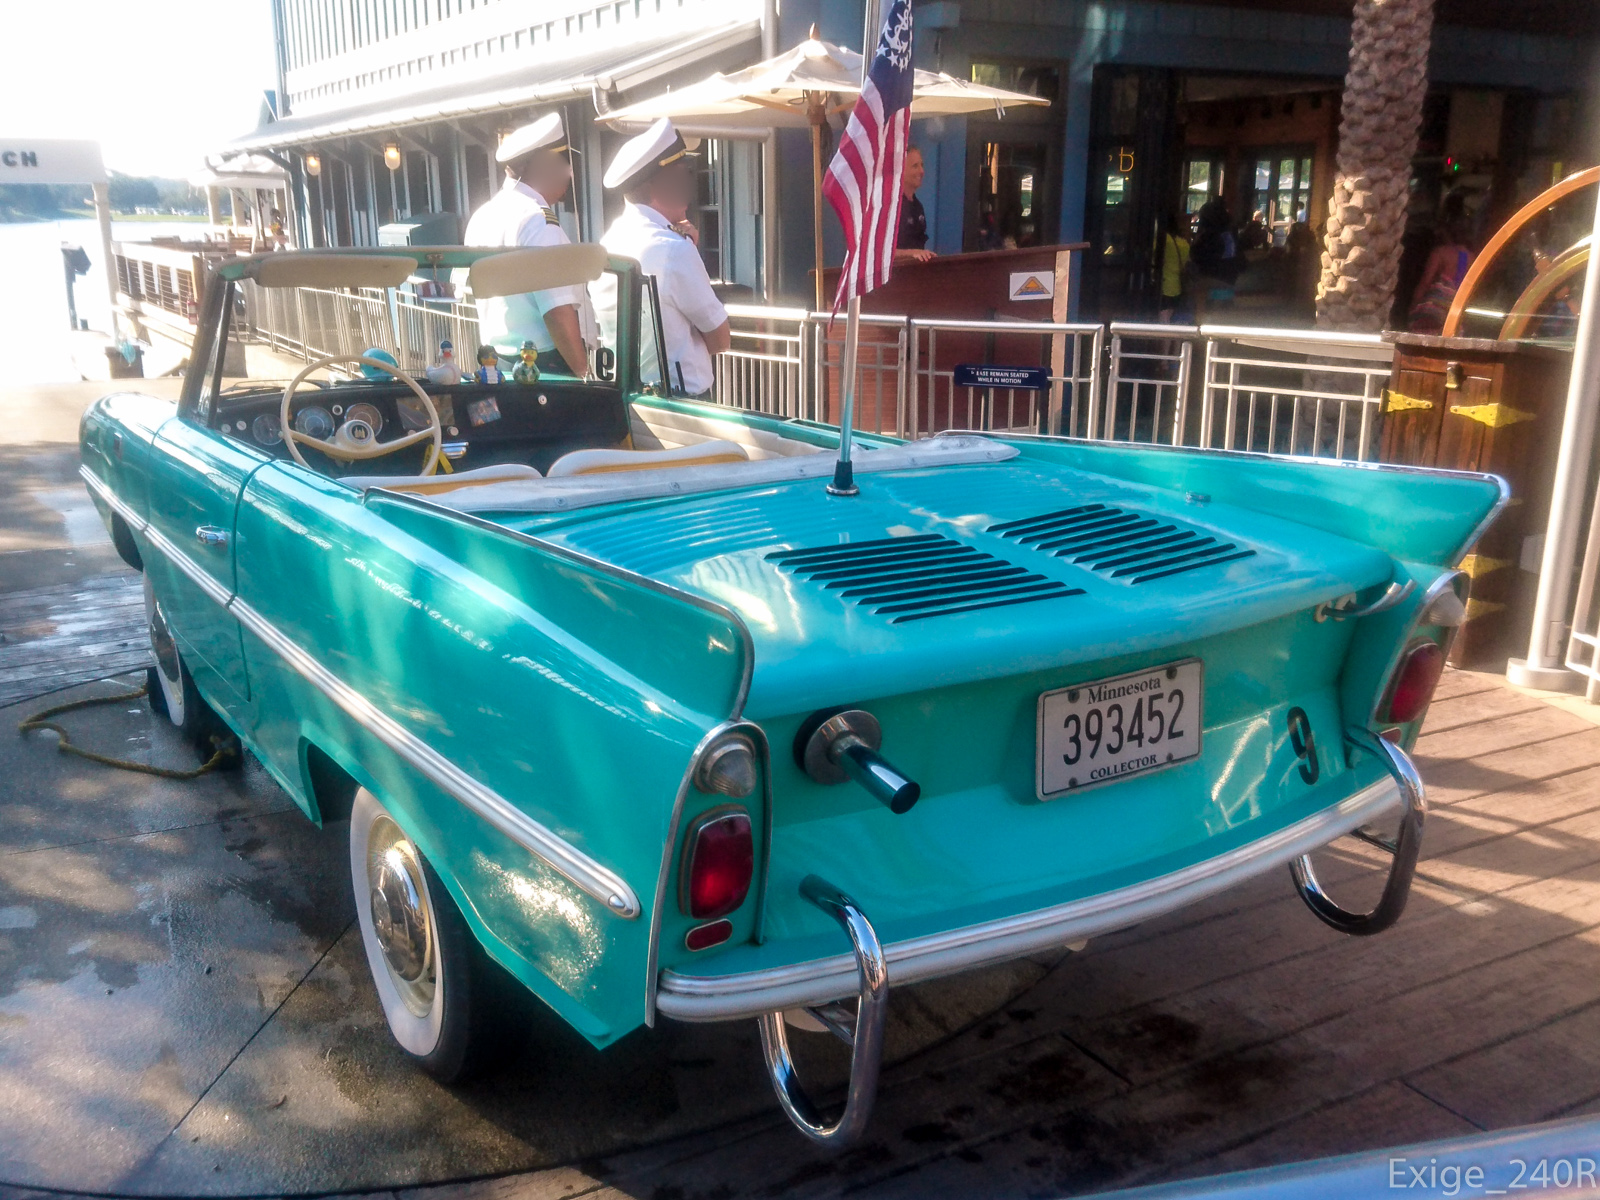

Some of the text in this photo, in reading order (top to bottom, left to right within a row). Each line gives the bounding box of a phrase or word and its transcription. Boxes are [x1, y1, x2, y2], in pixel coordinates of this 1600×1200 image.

[1087, 677, 1162, 704] Minnesota
[1063, 689, 1184, 766] 393452
[1287, 706, 1319, 786] 9
[1090, 754, 1158, 780] COLLECTOR
